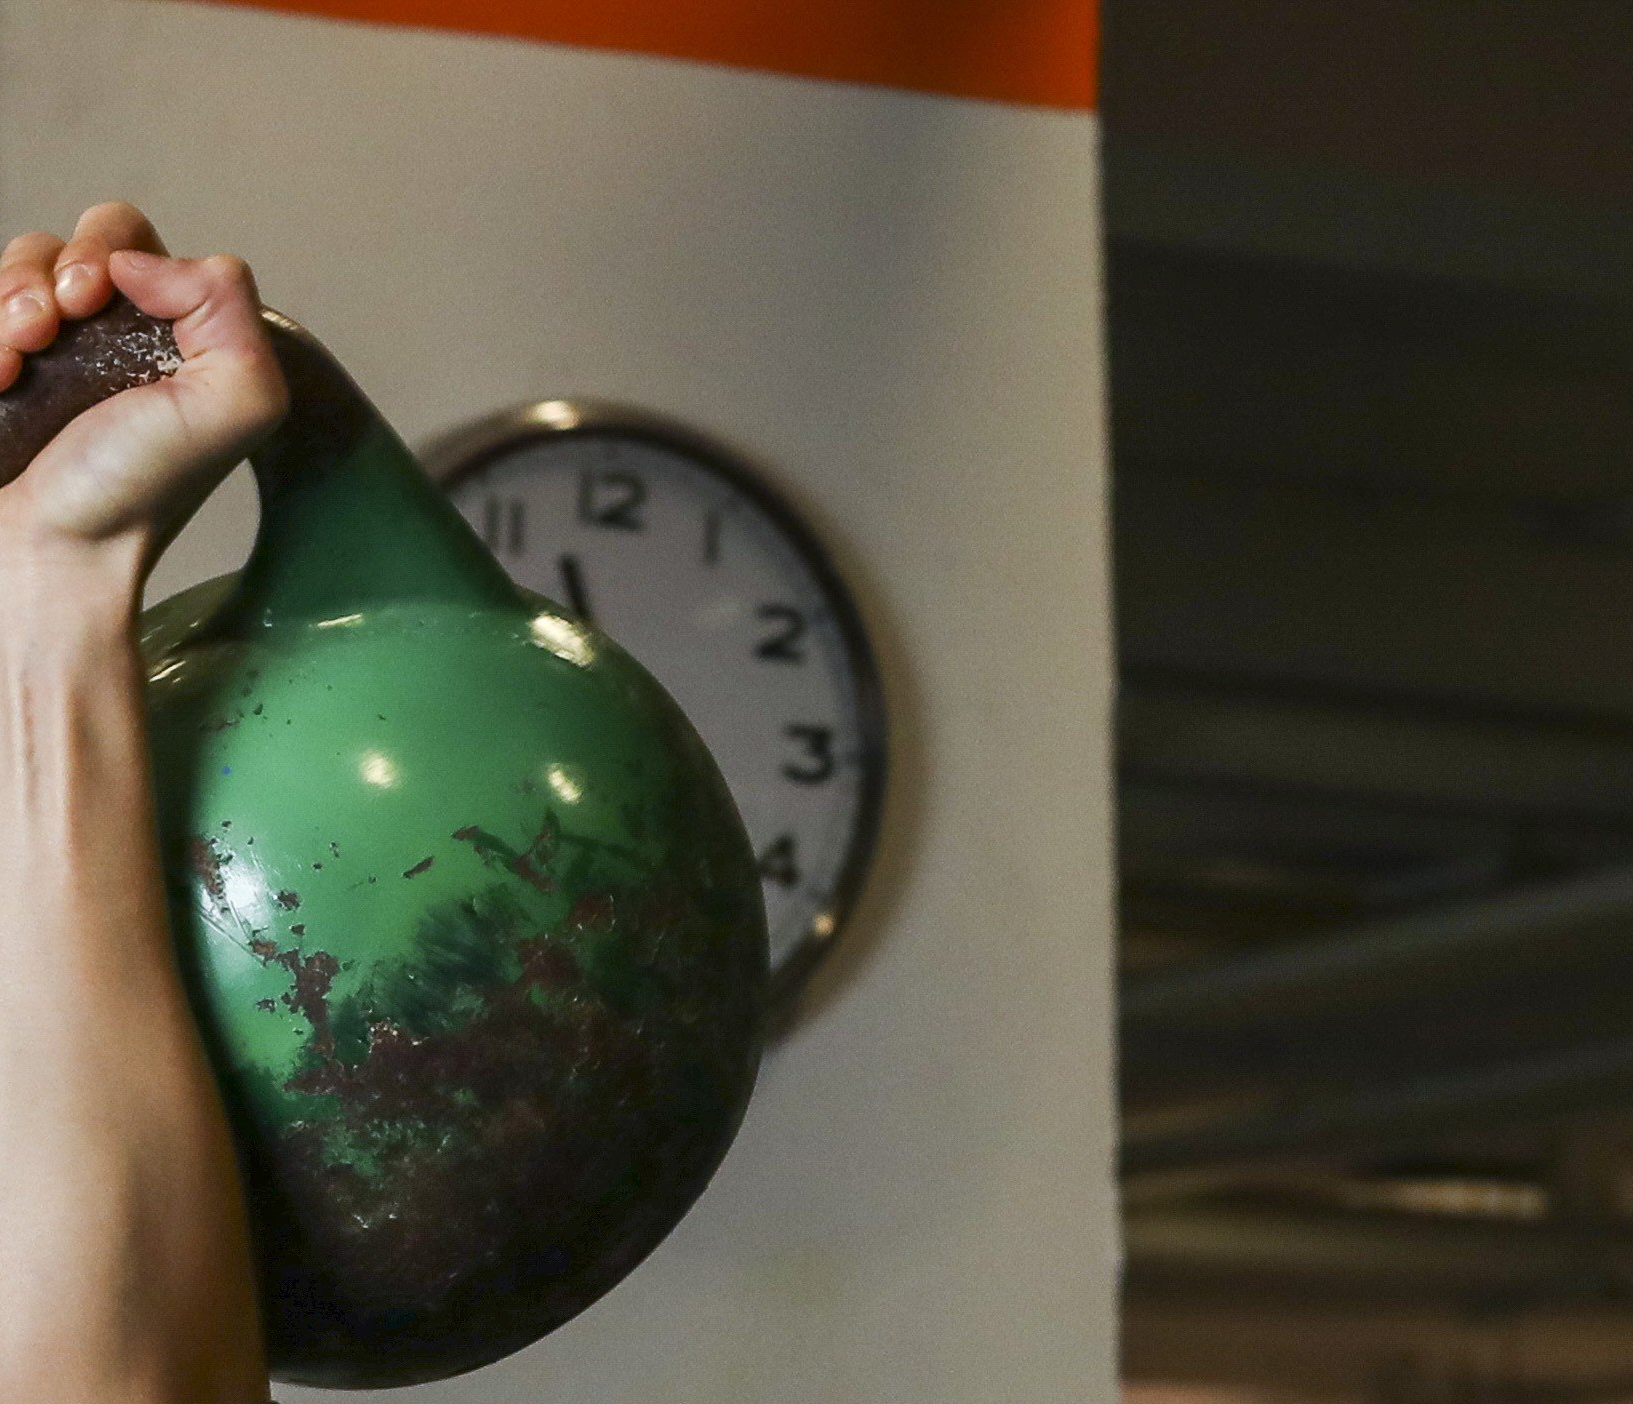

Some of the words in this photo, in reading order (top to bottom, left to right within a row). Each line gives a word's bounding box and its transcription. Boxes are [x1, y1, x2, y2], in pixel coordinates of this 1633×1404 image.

[483, 499, 527, 557] 11
[579, 472, 646, 533] 12
[703, 507, 723, 567] 1
[754, 606, 806, 662] 2
[779, 722, 835, 786] 3
[755, 834, 801, 890] 4
